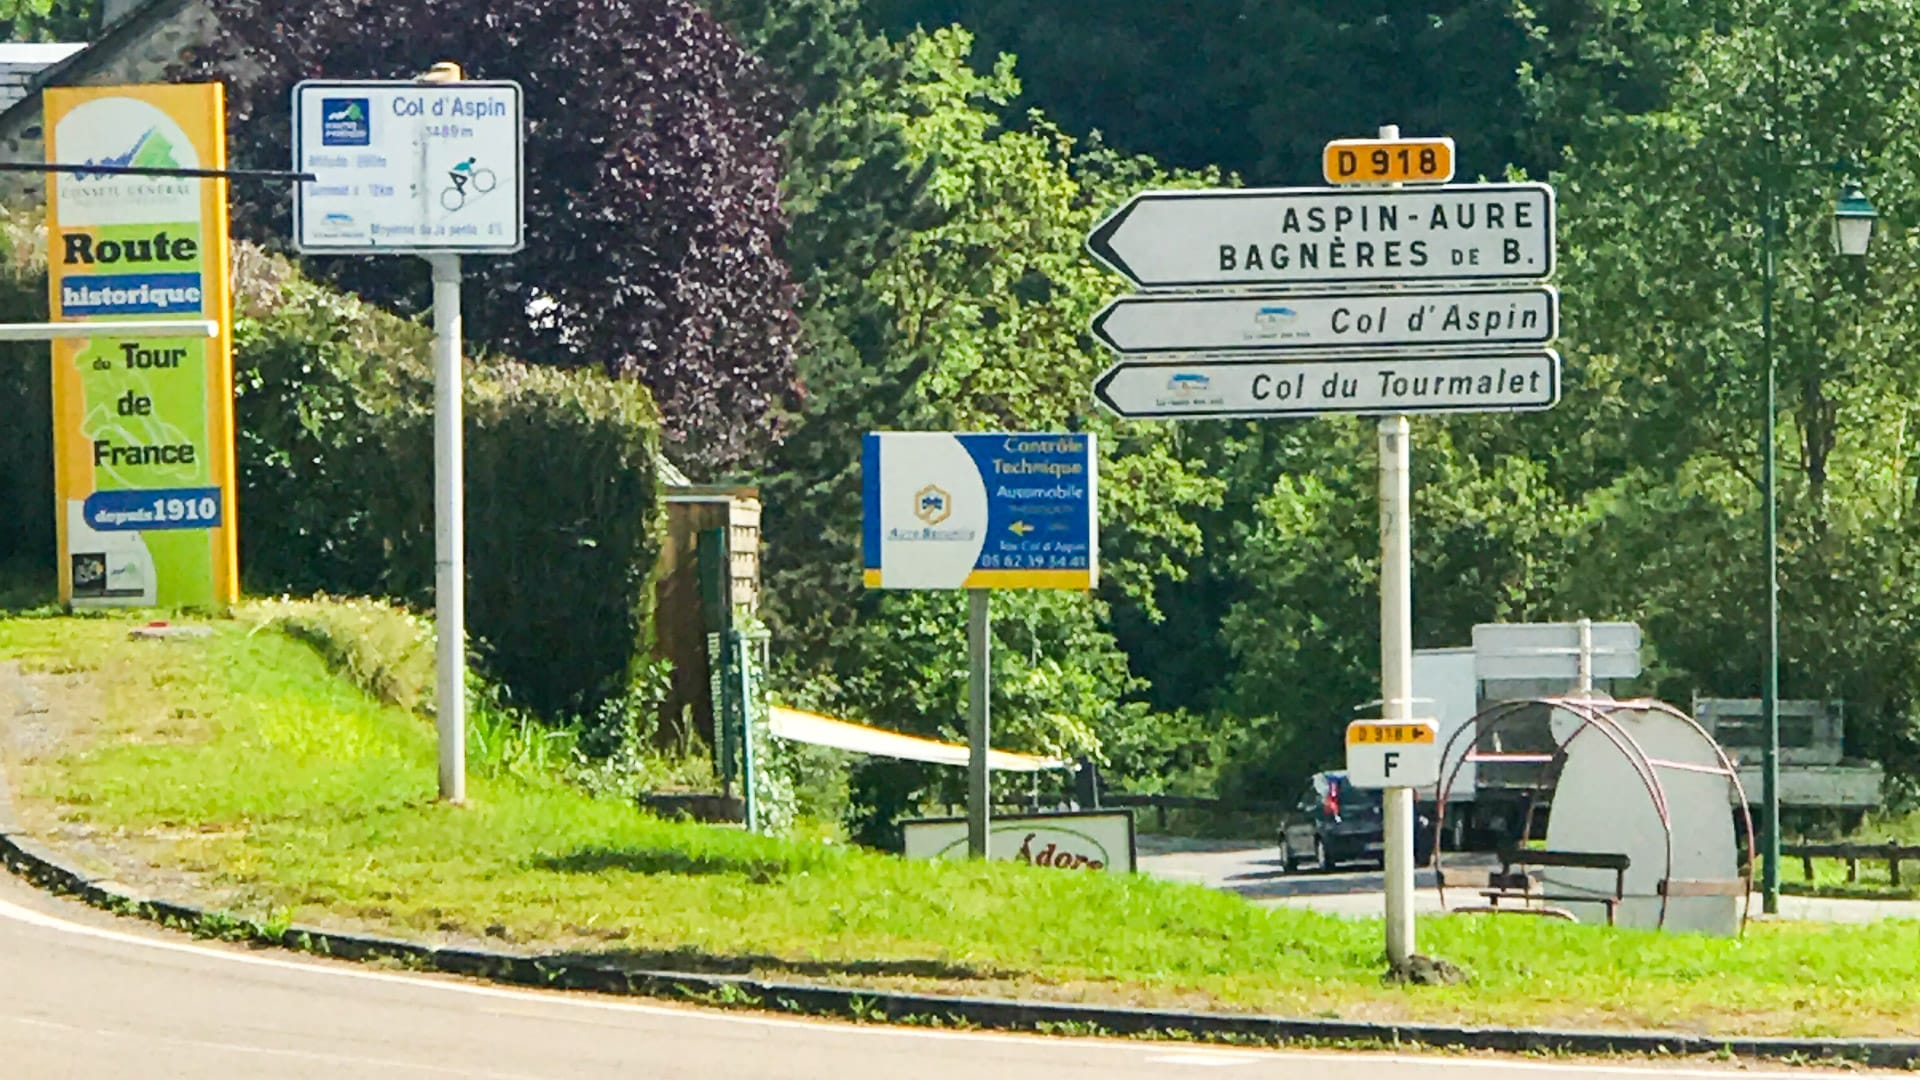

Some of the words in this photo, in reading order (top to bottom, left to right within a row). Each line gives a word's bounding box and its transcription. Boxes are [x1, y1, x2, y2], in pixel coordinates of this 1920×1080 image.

[392, 96, 424, 117] Col
[432, 96, 506, 121] d'Aspin
[1338, 150, 1357, 176] D
[1371, 148, 1438, 176] 918
[1282, 202, 1533, 234] ASPIN-AURE
[62, 231, 197, 264] Route
[1219, 235, 1429, 271] BAGNÈRES
[1451, 248, 1480, 266] DE
[1502, 238, 1535, 265] B.
[63, 284, 201, 308] historique
[1331, 306, 1387, 334] Col
[1407, 303, 1538, 337] d'Aspin
[93, 357, 111, 371] du
[119, 343, 188, 369] Tour
[1252, 373, 1304, 401] Col
[1322, 372, 1359, 398] du
[1378, 368, 1541, 398] Tourmalet
[117, 390, 152, 416] de
[94, 440, 195, 467] France
[992, 458, 1082, 480] Technique
[996, 484, 1083, 499] Automobile
[95, 508, 153, 526] depuis
[153, 497, 217, 521] 1910
[1358, 726, 1368, 742] D
[1384, 752, 1400, 778] F
